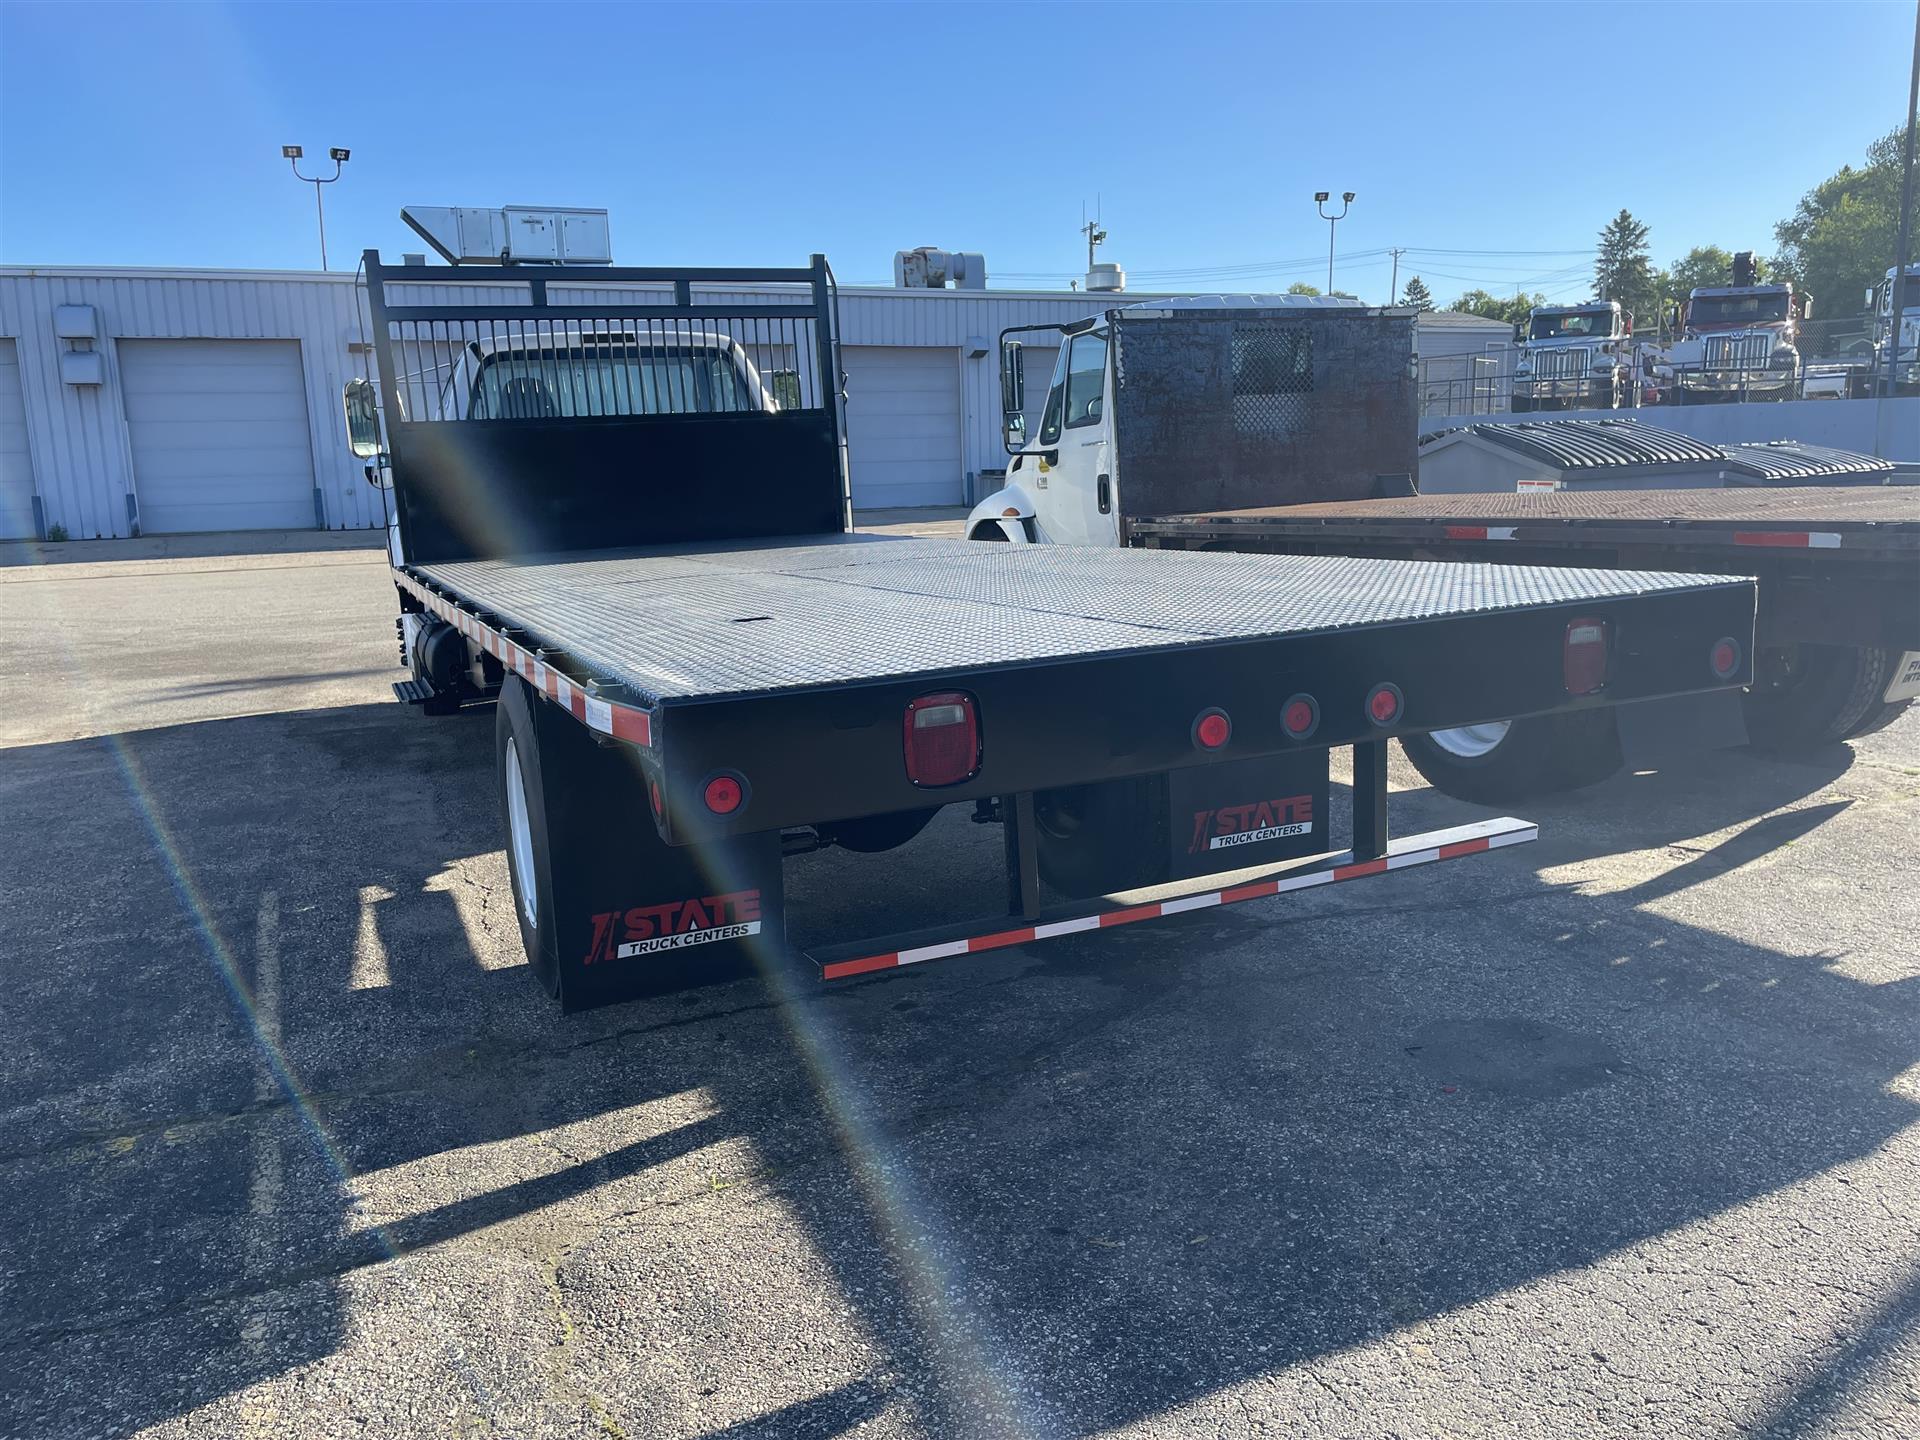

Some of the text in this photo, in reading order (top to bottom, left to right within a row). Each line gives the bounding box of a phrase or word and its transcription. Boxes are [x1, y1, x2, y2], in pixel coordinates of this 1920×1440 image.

[1219, 825, 1303, 847] TRUCK CENTERS
[630, 924, 749, 955] TRUCK CENTERS
